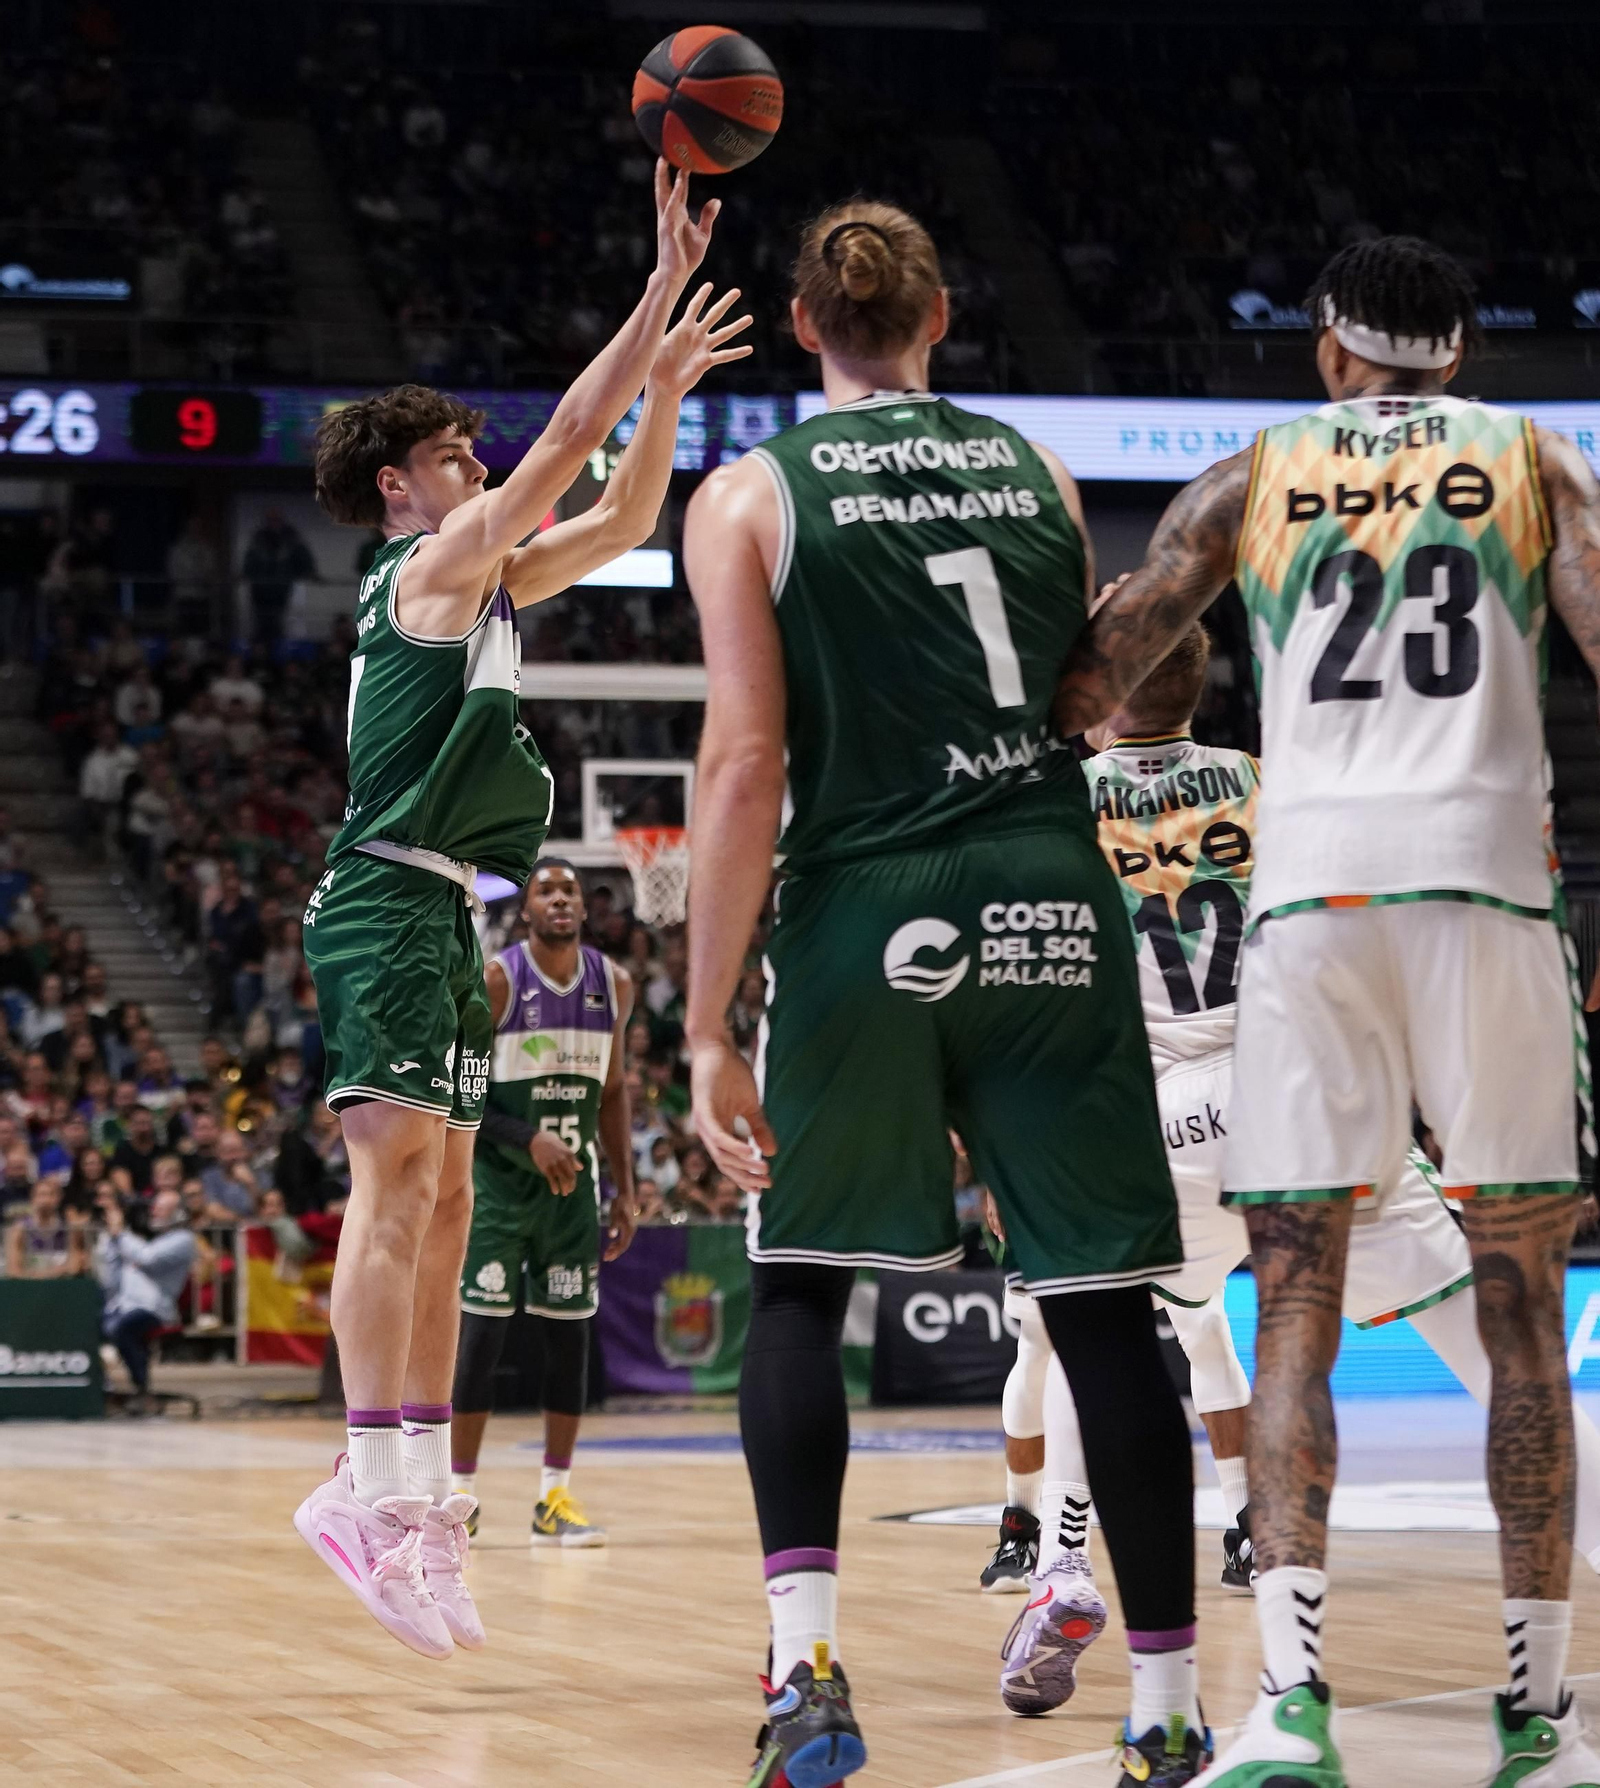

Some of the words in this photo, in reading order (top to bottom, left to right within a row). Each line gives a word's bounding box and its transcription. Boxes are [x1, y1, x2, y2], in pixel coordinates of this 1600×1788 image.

[177, 397, 218, 449] 9
[1119, 430, 1257, 455] PROM
[1333, 415, 1447, 457] KYSER
[810, 436, 1018, 475] OSETKOWSKI
[924, 545, 1027, 709] 1
[1310, 544, 1480, 704] 23
[979, 901, 1099, 933] COSTA
[980, 936, 1039, 963] DEL
[1042, 935, 1099, 962] SOL
[1132, 879, 1244, 1016] 12
[979, 961, 1093, 988] MÁLAGA
